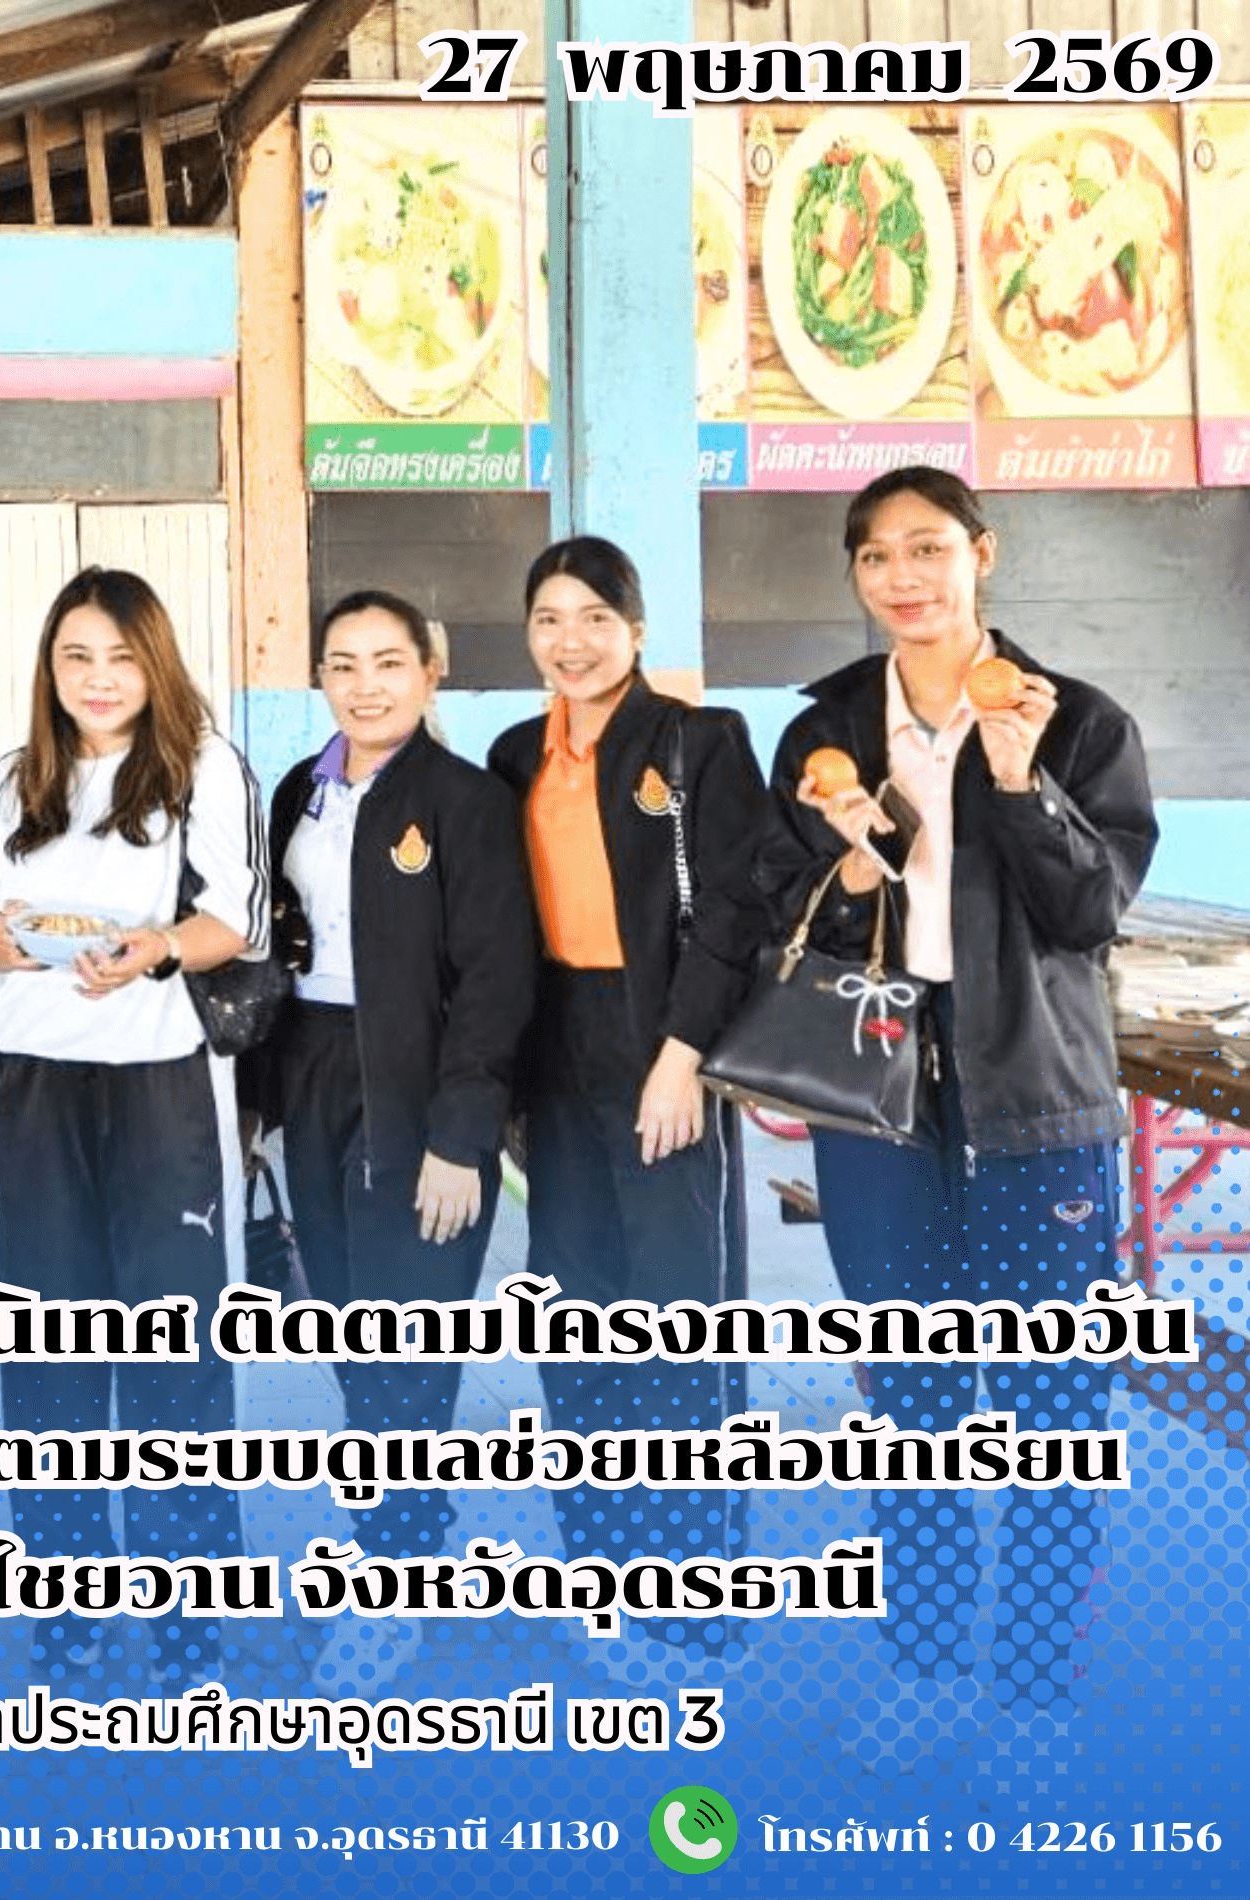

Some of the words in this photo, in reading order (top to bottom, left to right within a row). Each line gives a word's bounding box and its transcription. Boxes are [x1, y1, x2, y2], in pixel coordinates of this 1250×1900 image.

[756, 426, 967, 472] ผัดคะน้าหมกรอบ
